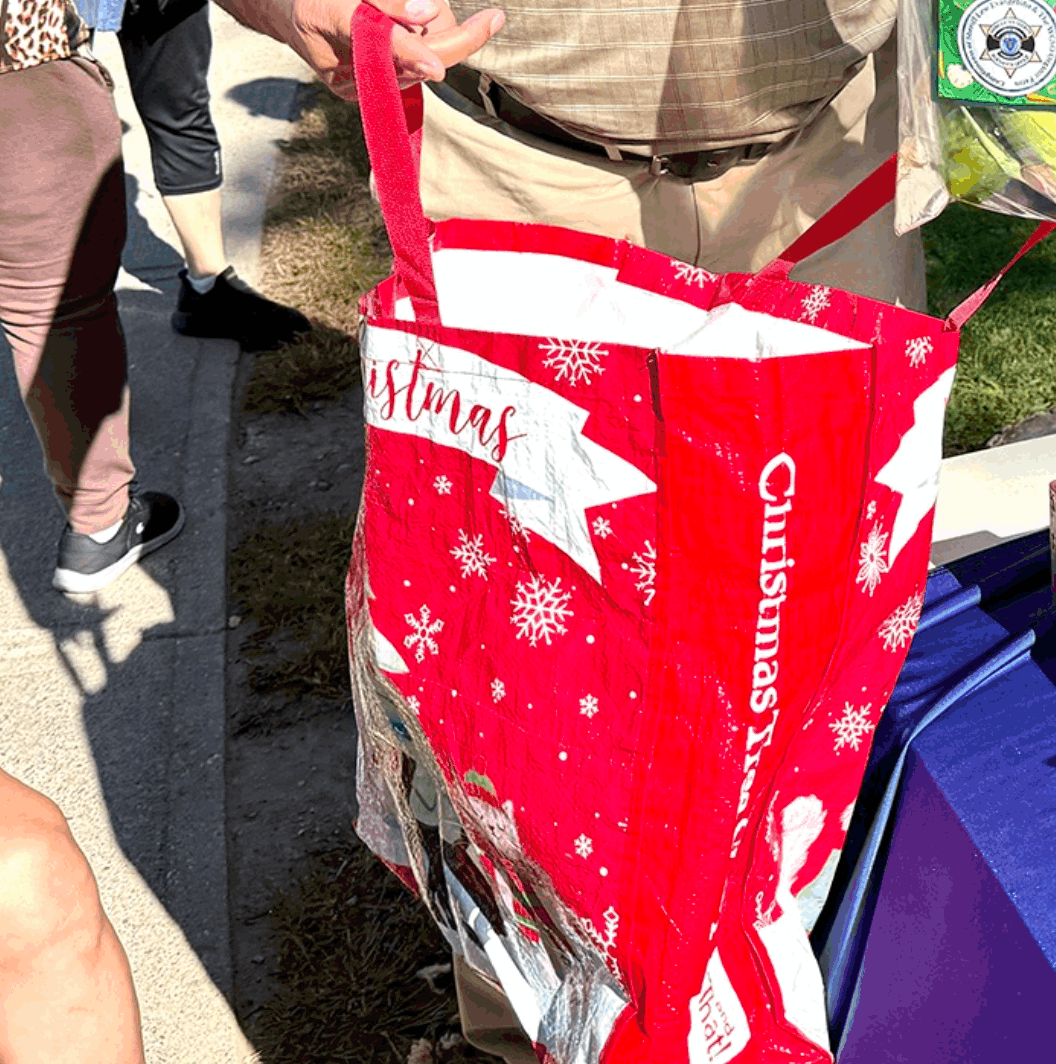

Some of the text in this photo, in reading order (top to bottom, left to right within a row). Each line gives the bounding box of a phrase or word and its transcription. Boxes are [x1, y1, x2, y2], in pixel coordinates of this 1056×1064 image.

[966, 15, 978, 39] Sheriff
[975, 6, 989, 18] Lew
[1039, 11, 1050, 24] The
[368, 349, 528, 462] istmas
[751, 452, 796, 714] Christmas
[715, 1002, 735, 1036] and
